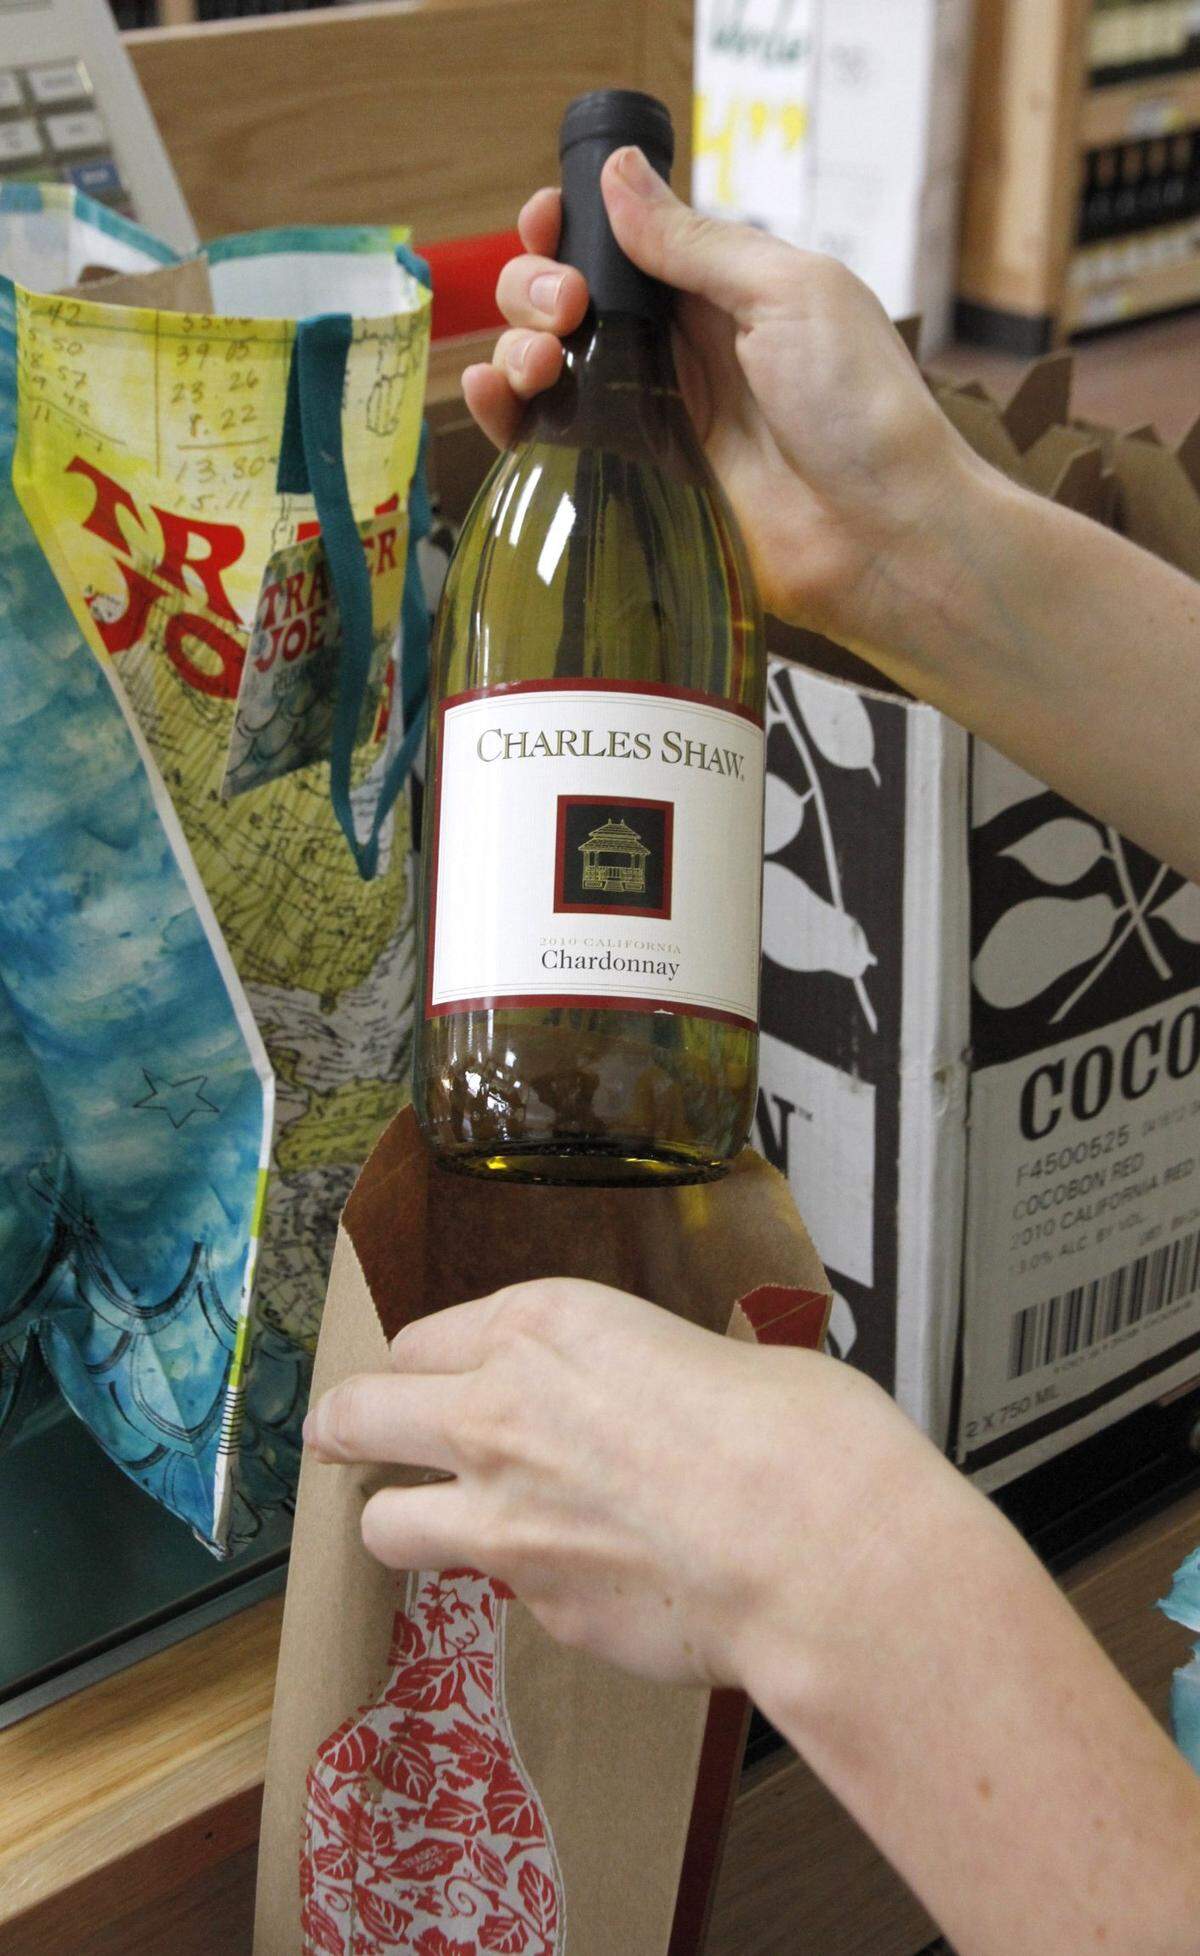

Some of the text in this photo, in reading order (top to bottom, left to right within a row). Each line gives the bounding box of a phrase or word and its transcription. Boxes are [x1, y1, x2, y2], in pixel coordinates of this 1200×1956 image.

[477, 728, 651, 763] CHARLES
[539, 936, 682, 955] 2010 CALIFORNIA
[541, 949, 681, 981] Chardonnay
[1012, 1151, 1145, 1221] COCOBON RED
